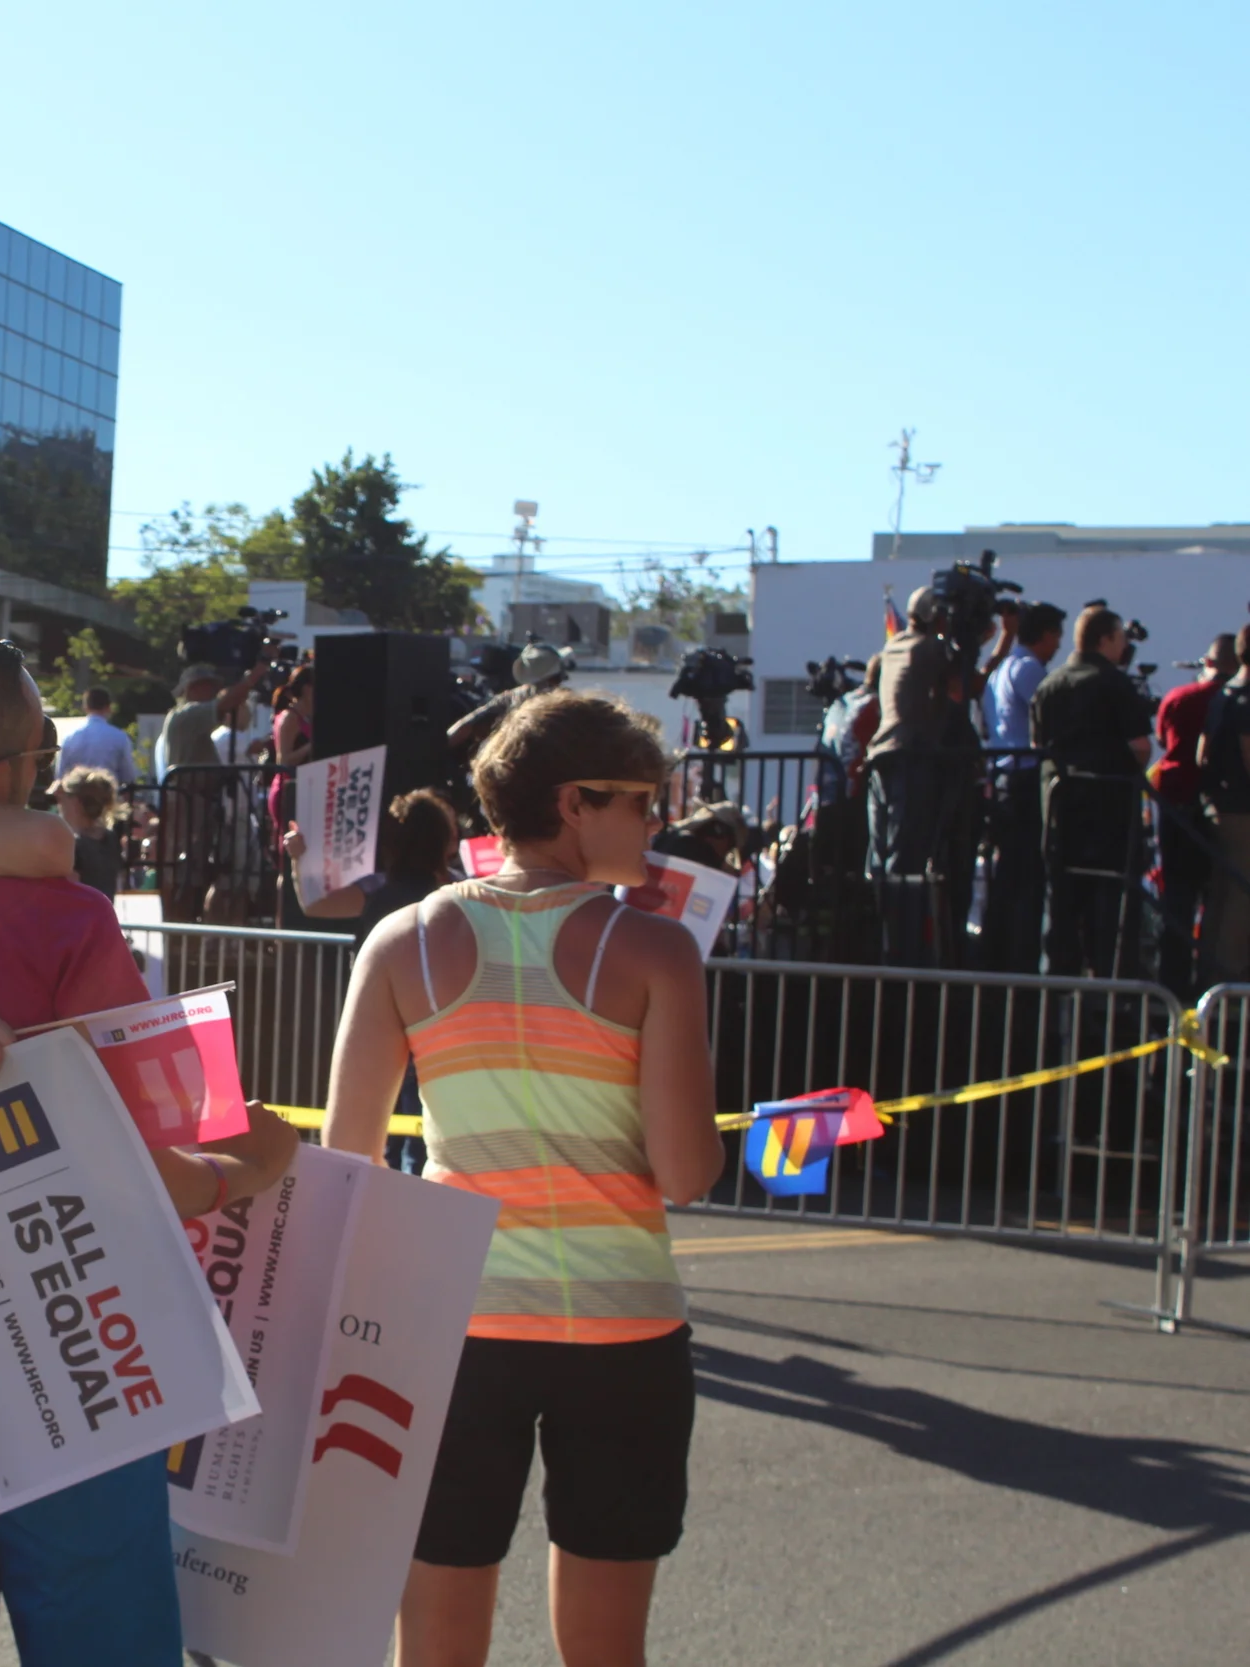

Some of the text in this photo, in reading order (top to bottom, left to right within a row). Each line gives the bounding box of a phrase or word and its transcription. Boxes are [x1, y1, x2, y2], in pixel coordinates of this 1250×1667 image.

[332, 786, 346, 859] MORE
[342, 766, 361, 871] WE ARE
[354, 762, 374, 866] TODAY
[128, 1005, 213, 1033] WWW.HRC.ORG
[6, 1201, 119, 1432] IS EQUAL
[46, 1195, 163, 1417] ALL LOVE
[250, 1329, 265, 1354] US
[258, 1176, 296, 1307] WWW.HRC.ORG
[4, 1312, 65, 1449] WWW.HRC.ORG
[339, 1313, 382, 1346] on
[204, 1426, 229, 1497] HUMAN
[222, 1430, 246, 1501] RIGHTS
